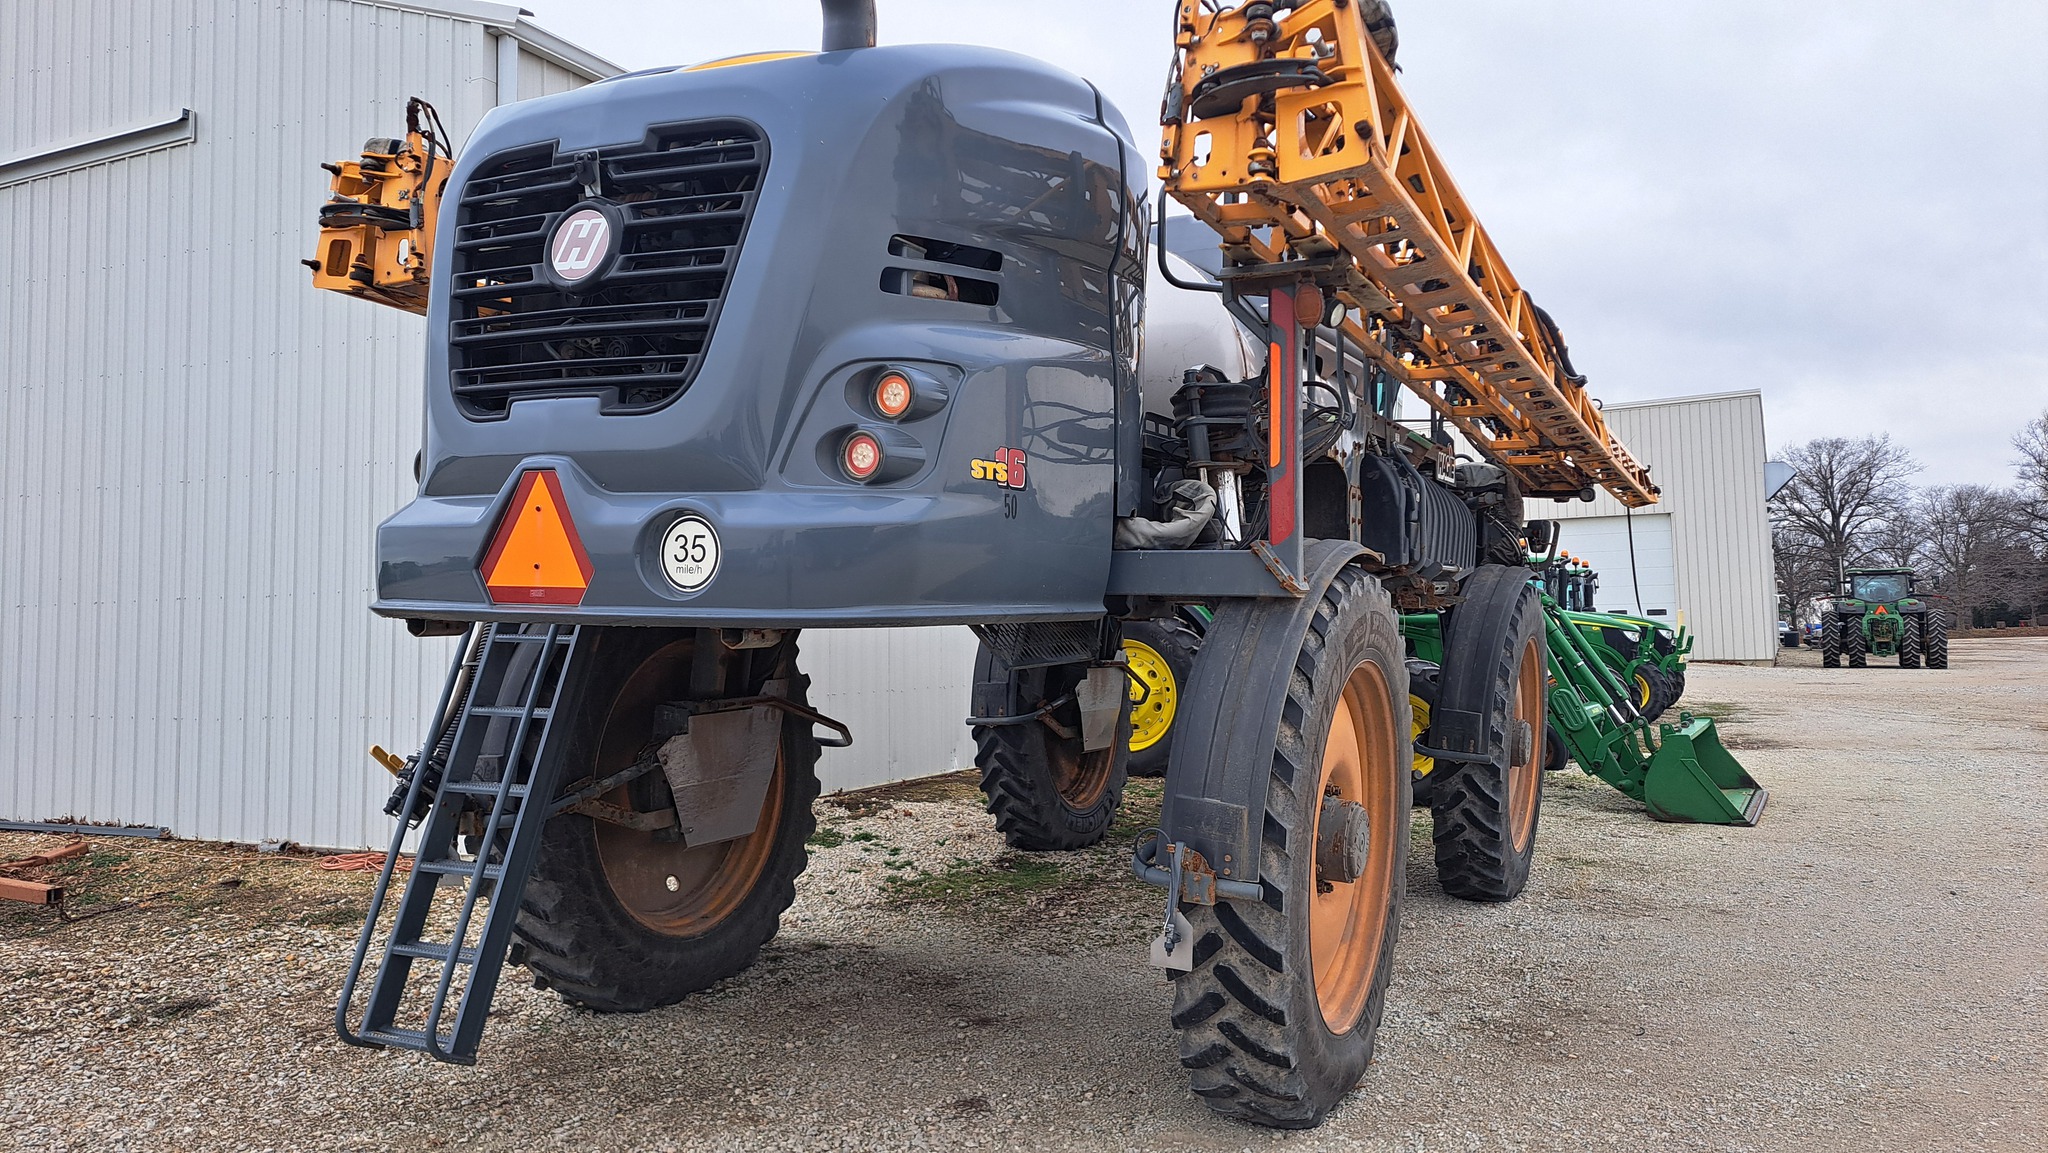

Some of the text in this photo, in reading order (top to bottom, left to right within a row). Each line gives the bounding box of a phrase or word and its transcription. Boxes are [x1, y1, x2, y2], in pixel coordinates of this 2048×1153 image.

[1004, 493, 1018, 519] 50
[673, 533, 706, 563] 35
[675, 564, 703, 575] mile/h
